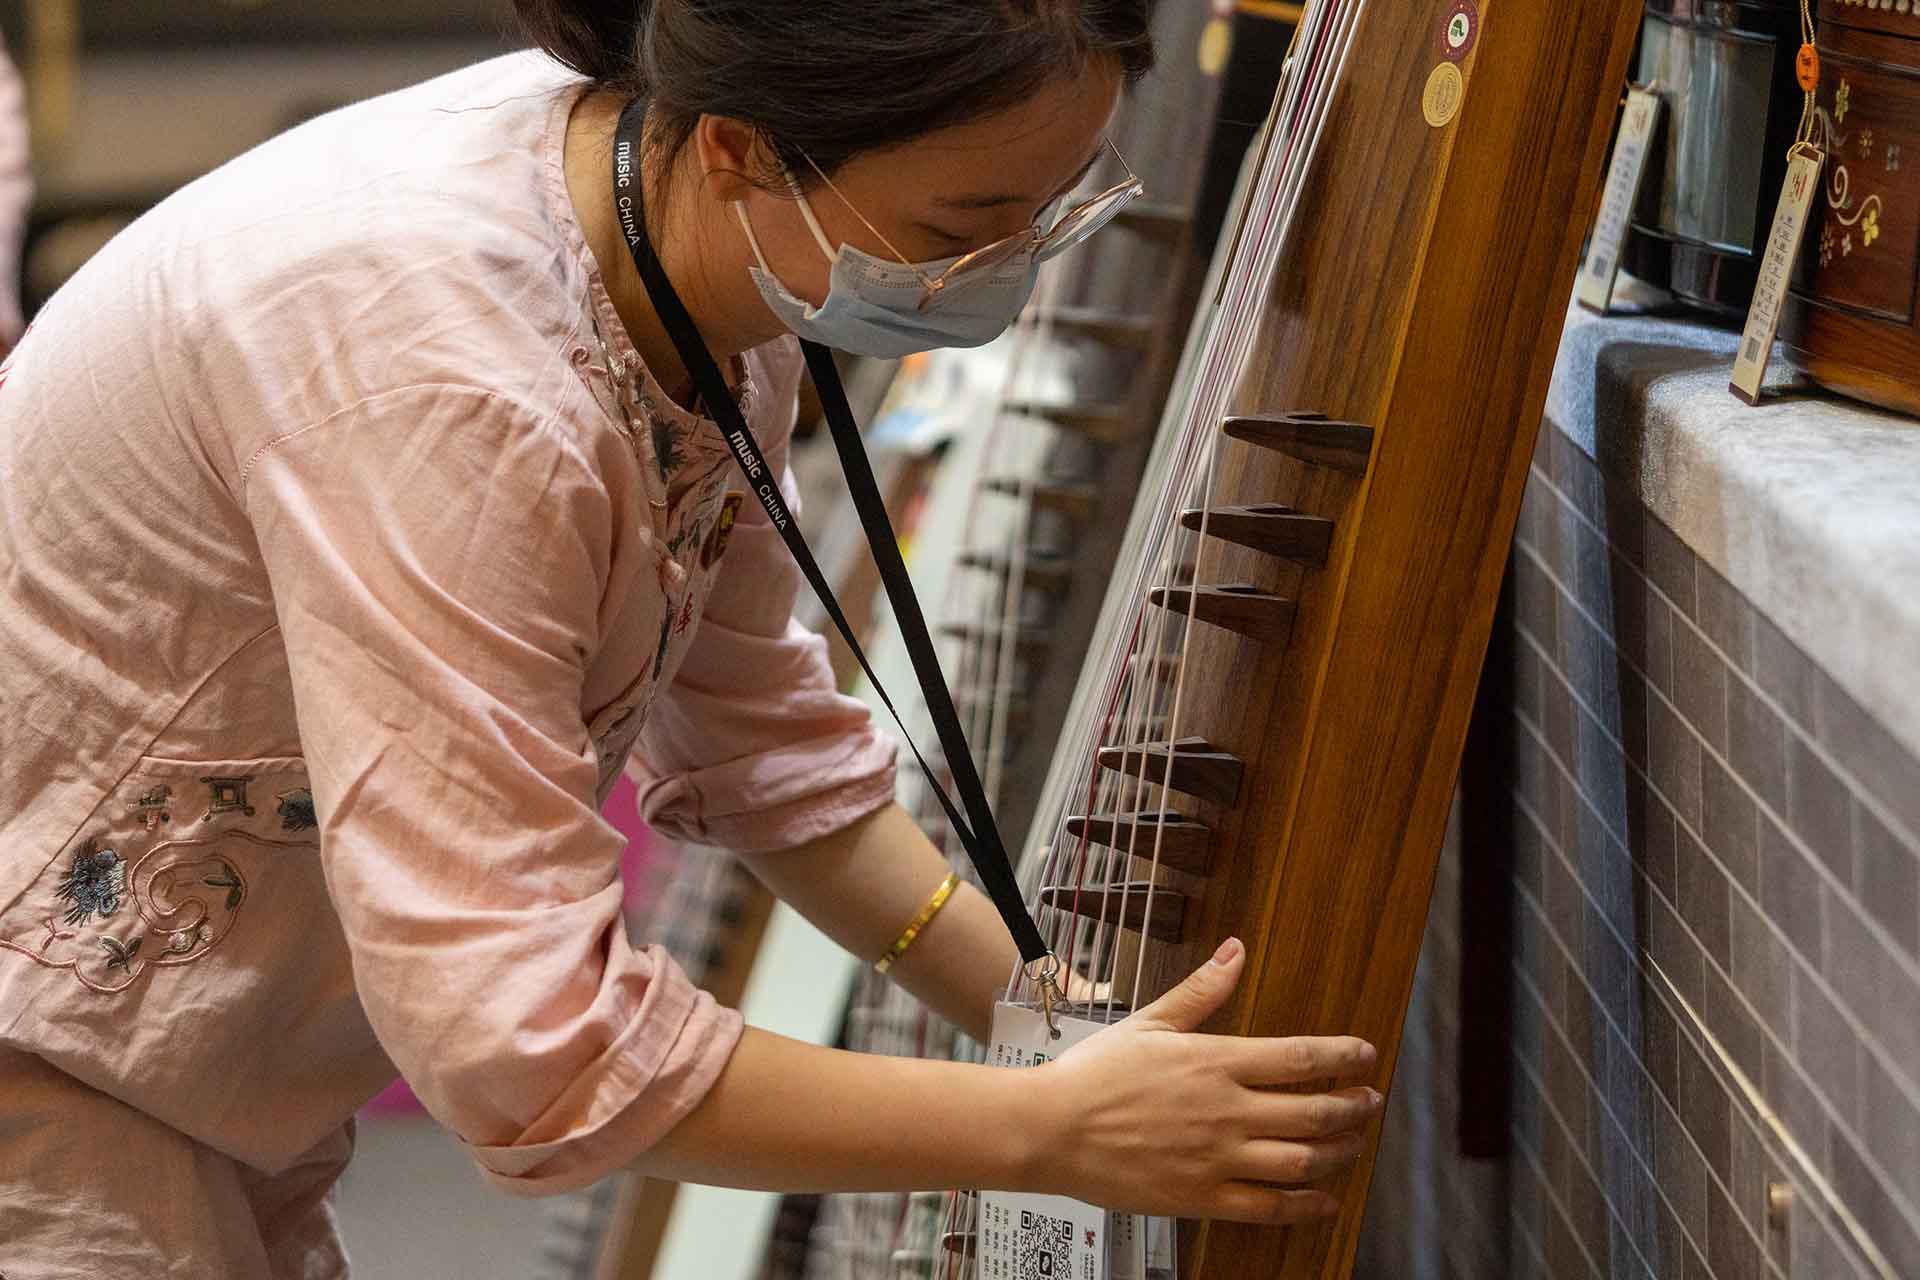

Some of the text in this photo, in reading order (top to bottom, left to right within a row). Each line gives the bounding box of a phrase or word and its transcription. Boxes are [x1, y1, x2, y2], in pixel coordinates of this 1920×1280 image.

[617, 141, 641, 246] music CHINA
[729, 430, 787, 530] music CHINA
